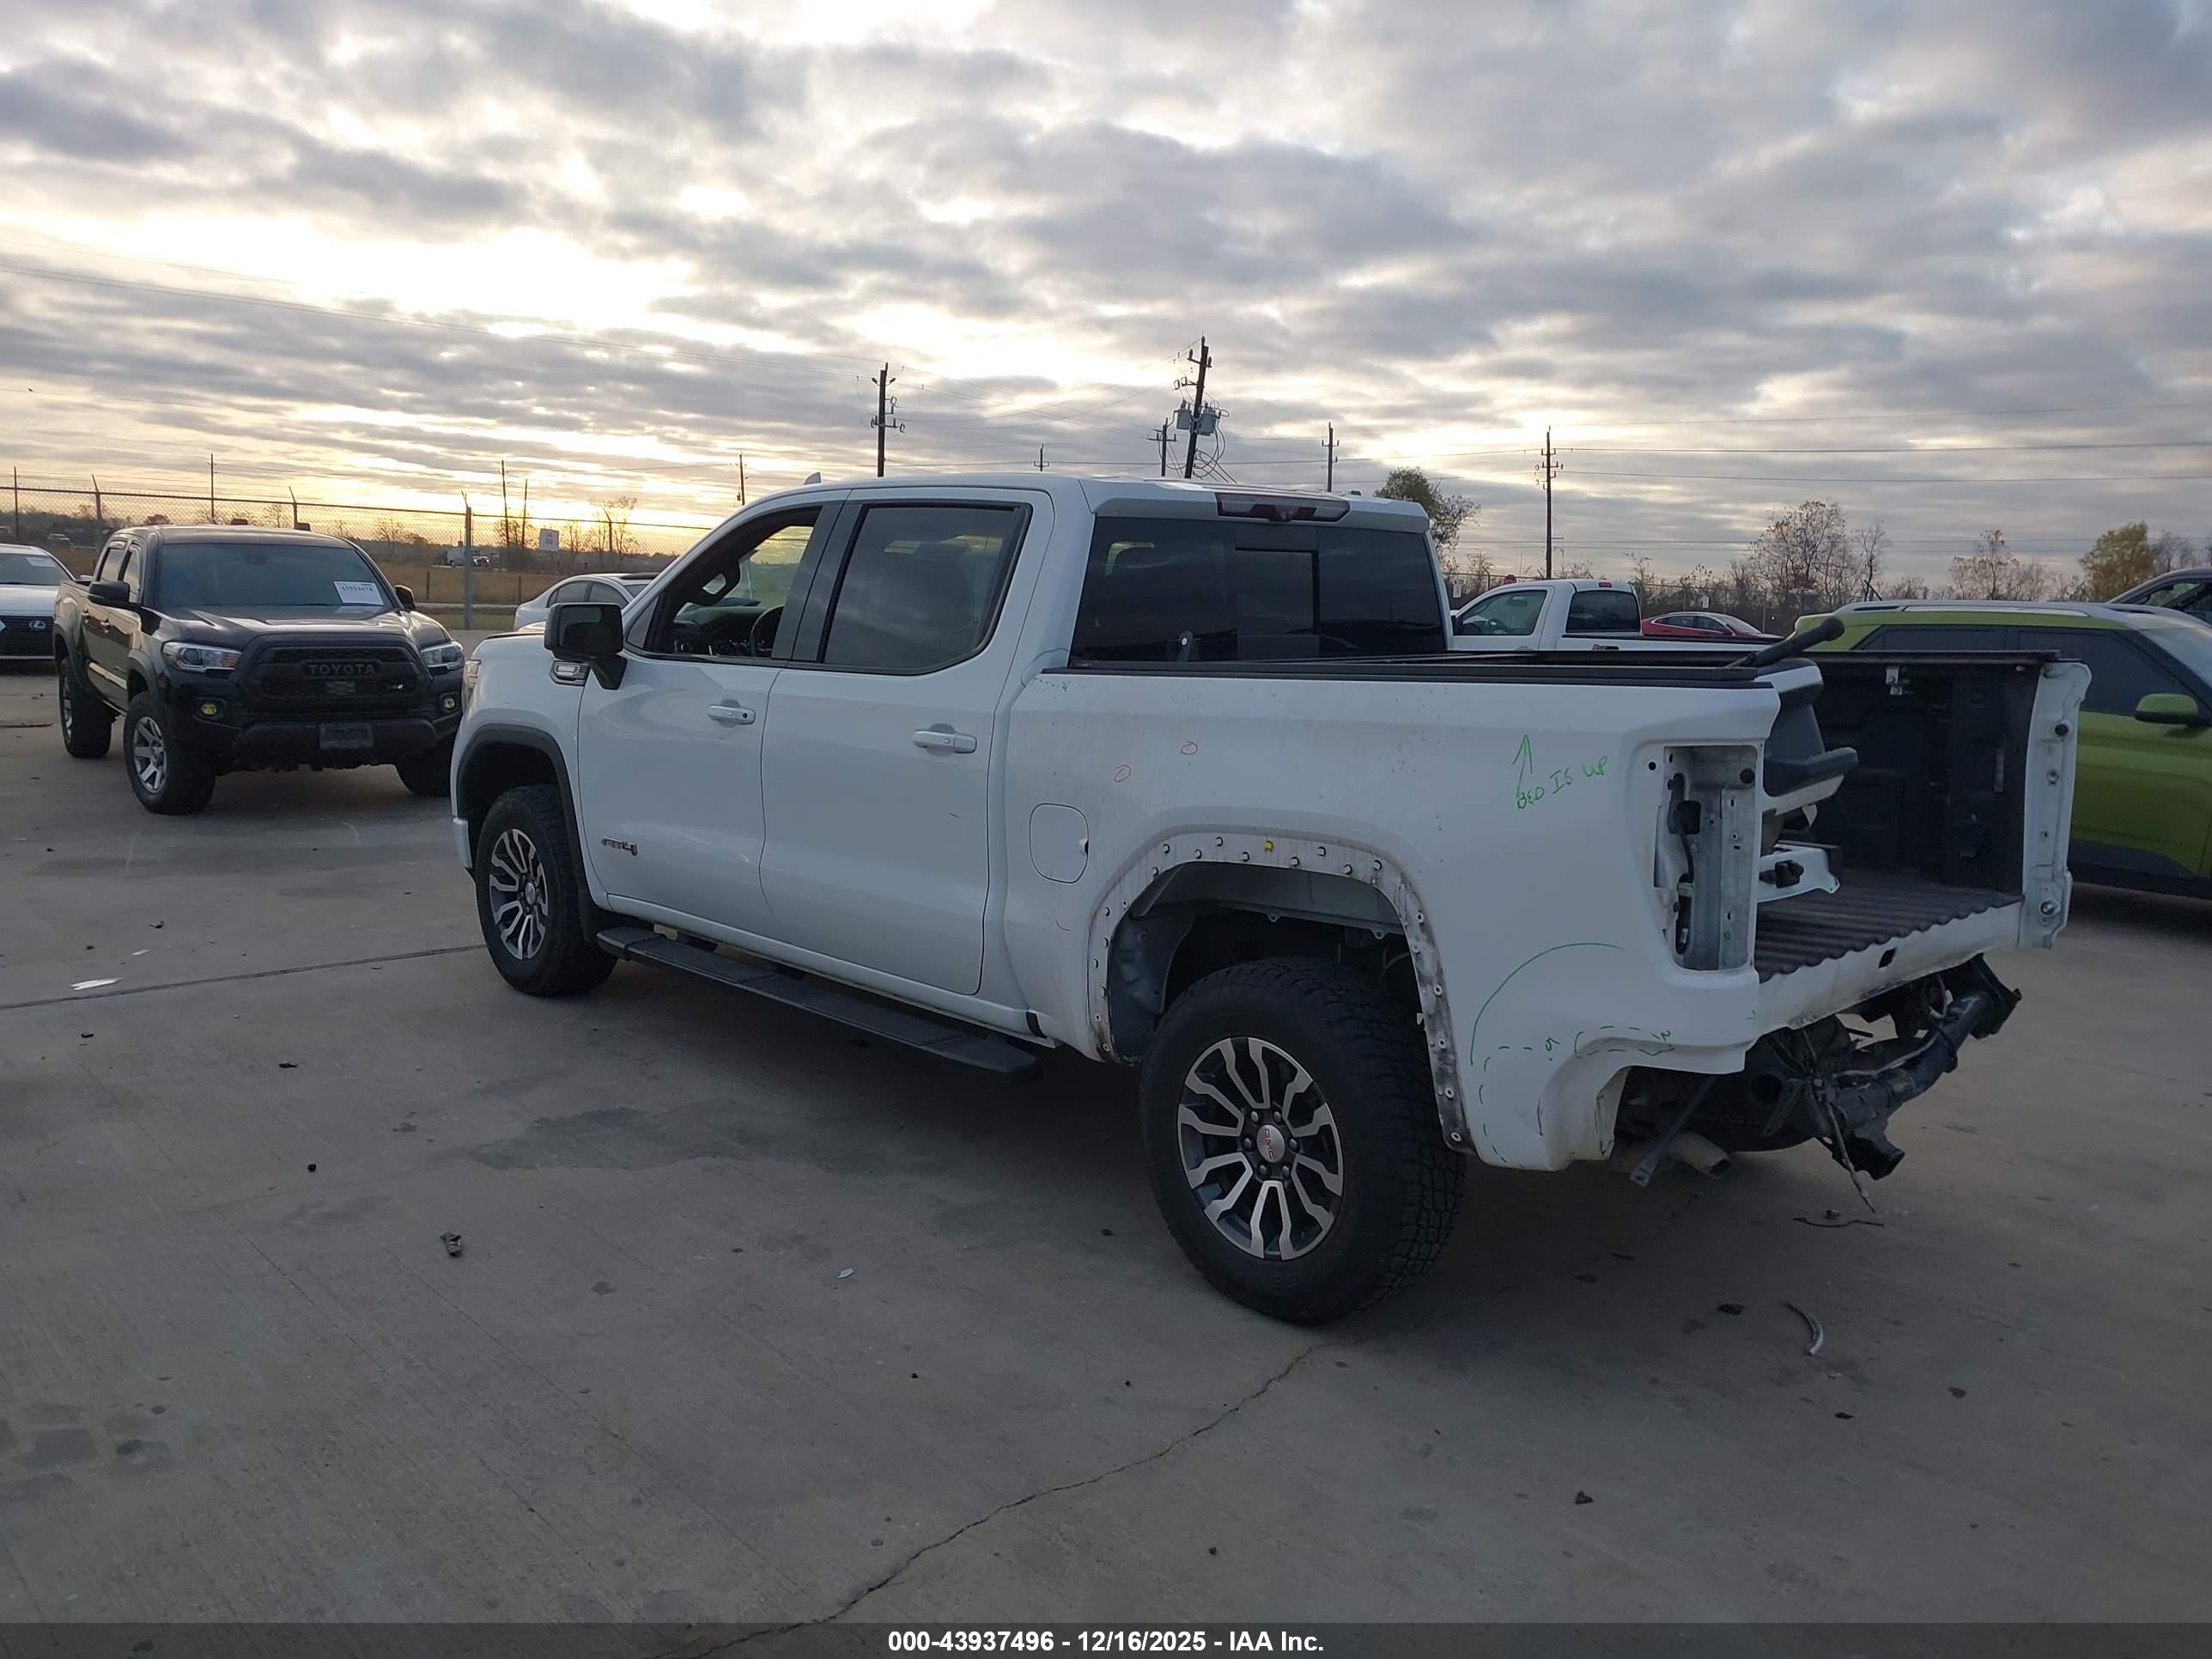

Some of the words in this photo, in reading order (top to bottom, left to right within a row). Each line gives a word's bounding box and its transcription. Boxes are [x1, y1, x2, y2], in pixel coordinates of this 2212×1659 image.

[309, 664, 375, 675] TOYOTA
[1517, 786, 1545, 809] BED
[1550, 768, 1573, 794] IS
[1264, 1128, 1275, 1160] GMC
